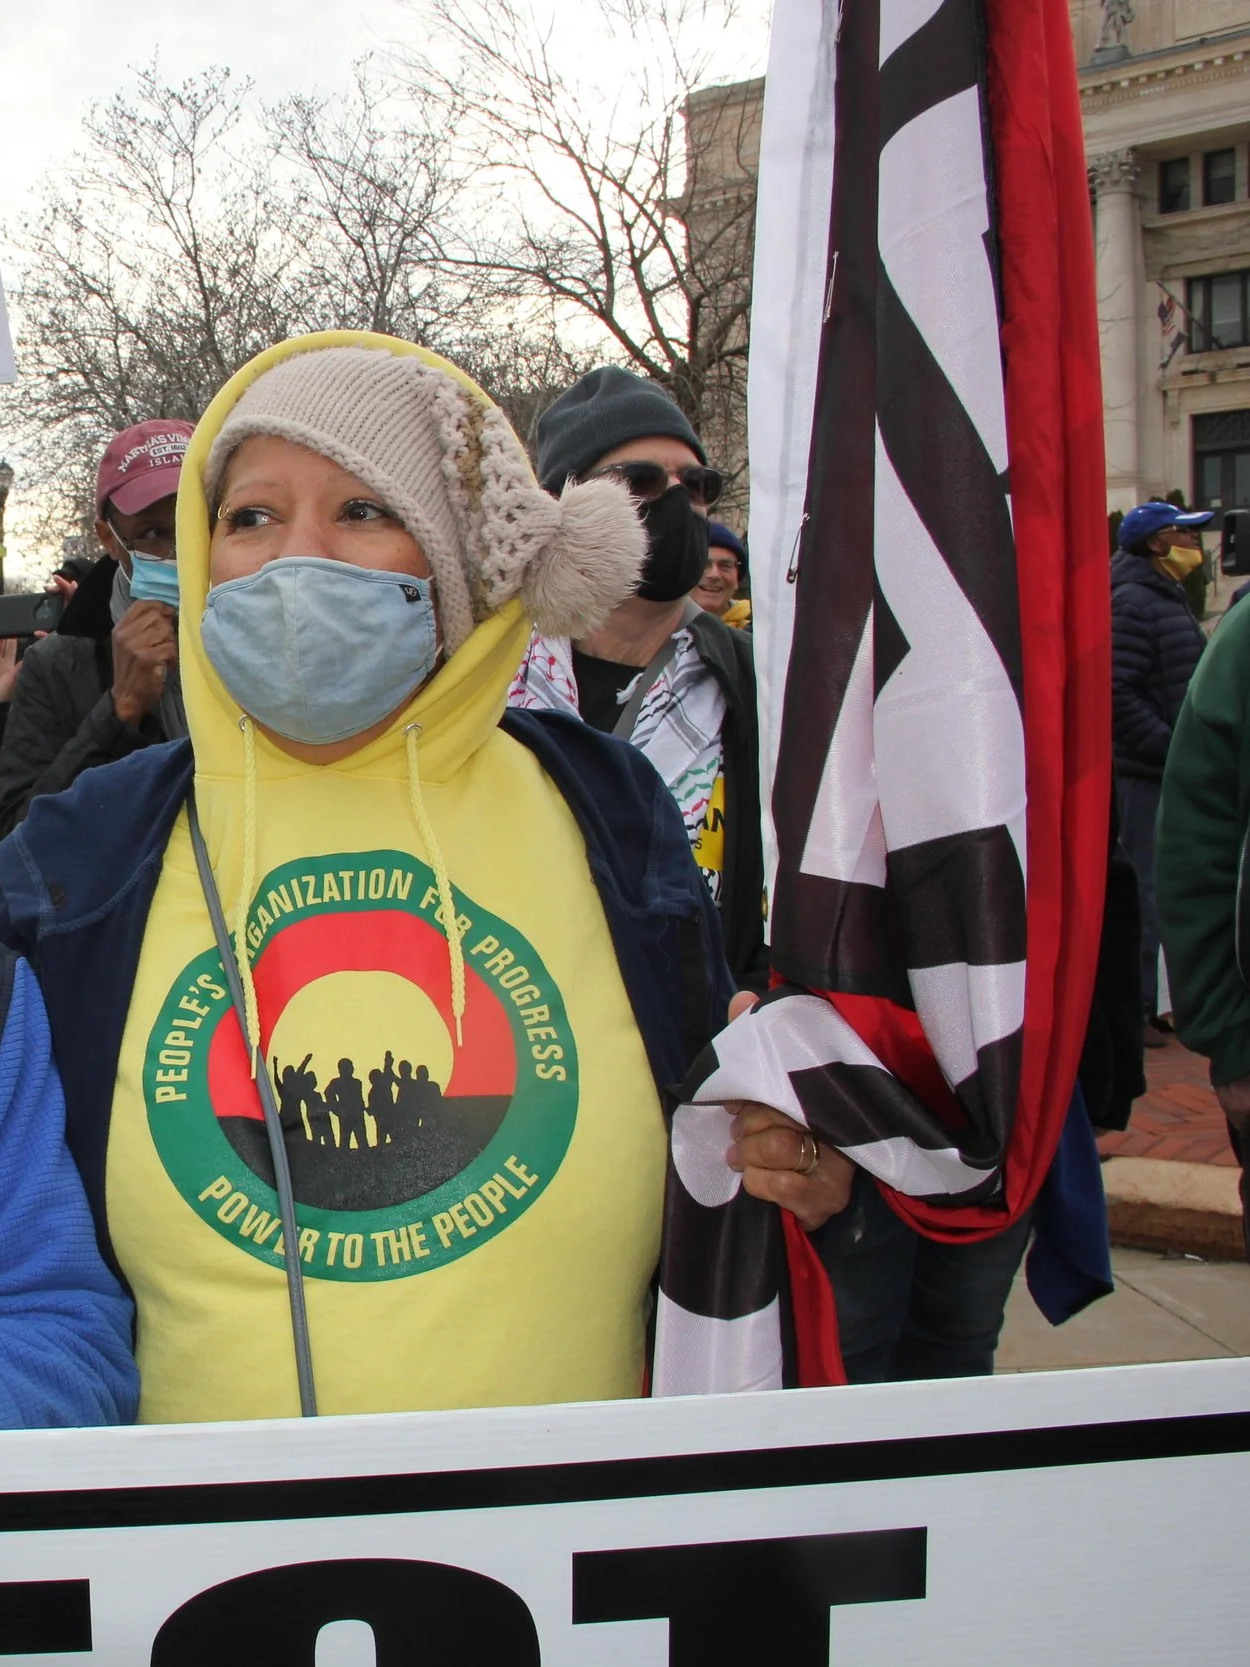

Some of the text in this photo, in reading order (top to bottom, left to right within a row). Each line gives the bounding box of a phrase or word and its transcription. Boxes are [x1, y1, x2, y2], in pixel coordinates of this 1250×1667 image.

[155, 973, 227, 1104] PEOPLE'S
[218, 868, 414, 971] GANIZATION
[470, 934, 567, 1083] PROGRESS
[326, 1231, 364, 1269] TO
[370, 1221, 431, 1268] THE
[432, 1155, 539, 1249] PEOPLE
